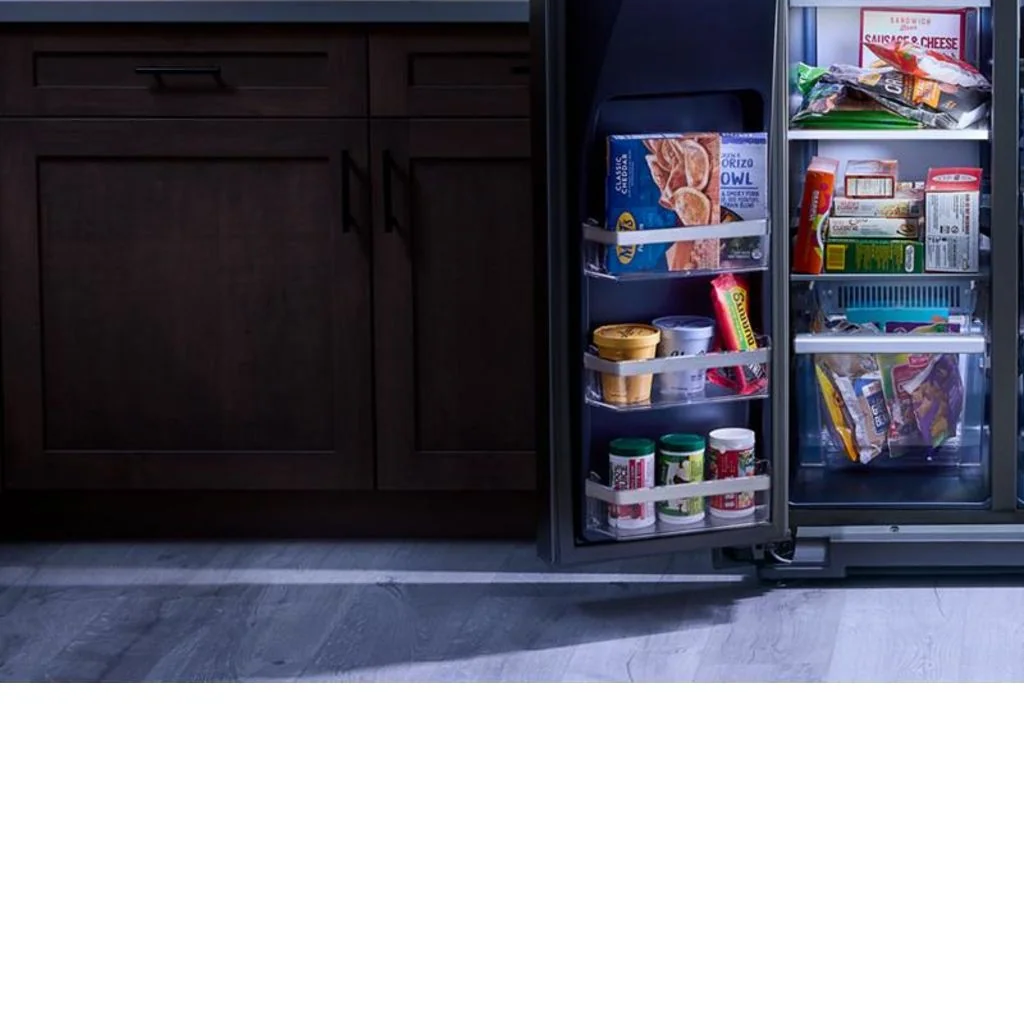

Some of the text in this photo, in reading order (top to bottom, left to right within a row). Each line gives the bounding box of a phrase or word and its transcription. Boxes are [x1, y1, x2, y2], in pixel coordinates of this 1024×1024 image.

[920, 36, 958, 50] CHEESE
[721, 158, 754, 168] ORIZO
[720, 172, 753, 185] OWL
